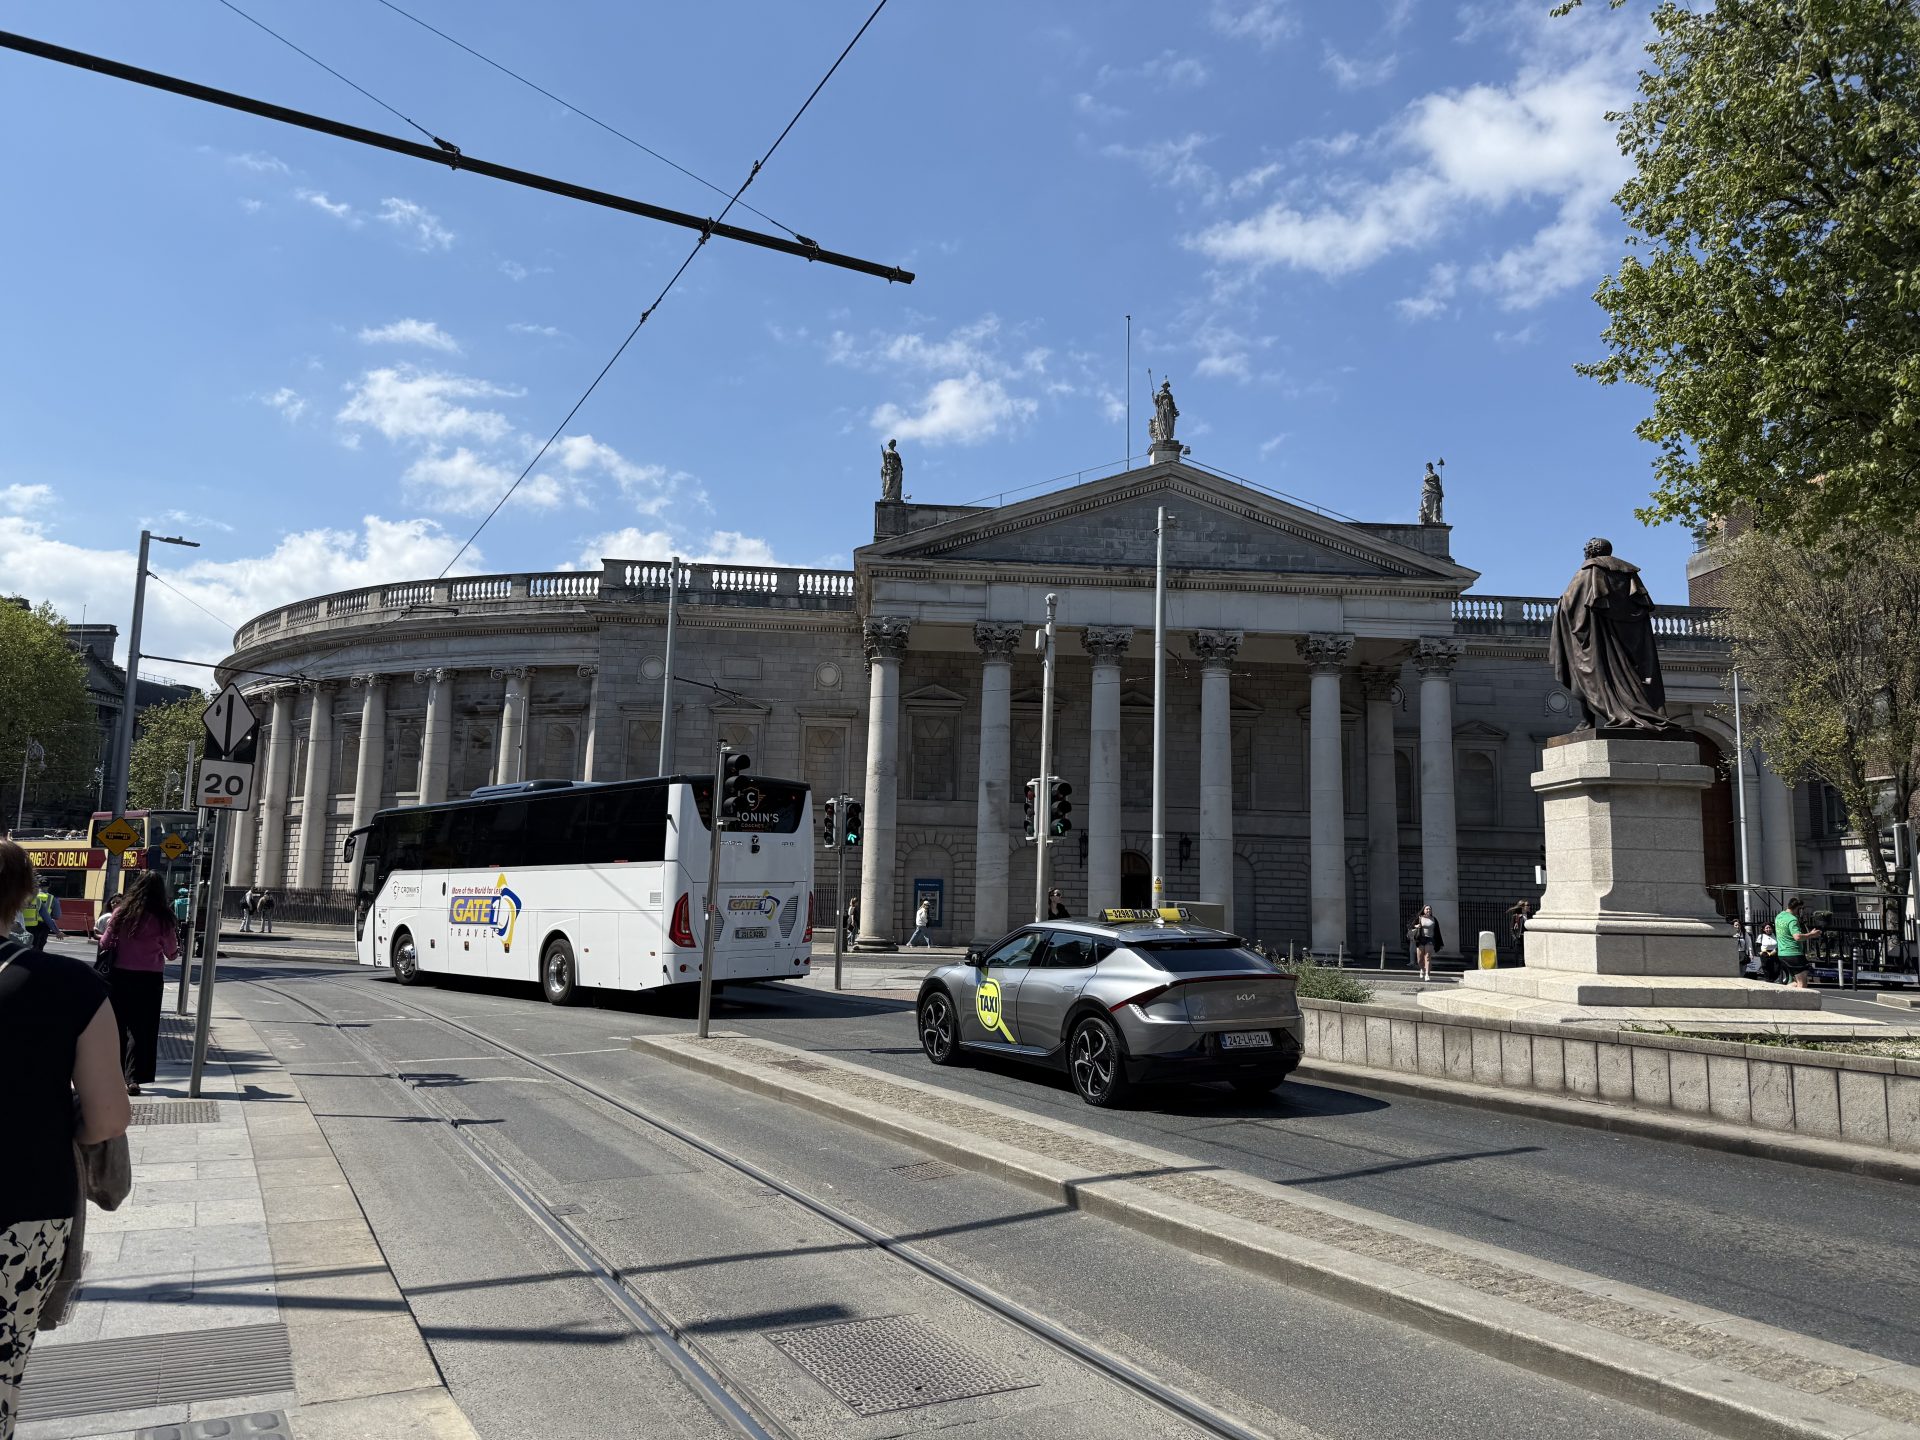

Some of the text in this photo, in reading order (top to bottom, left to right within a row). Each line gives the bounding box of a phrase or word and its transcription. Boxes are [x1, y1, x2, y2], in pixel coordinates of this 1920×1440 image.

[204, 773, 244, 796] 20
[737, 811, 780, 823] ONIN'S
[57, 852, 88, 867] DUBLIN
[1133, 909, 1160, 919] TAXI
[450, 928, 495, 938] TRAVEL
[980, 995, 998, 1014] TAXI
